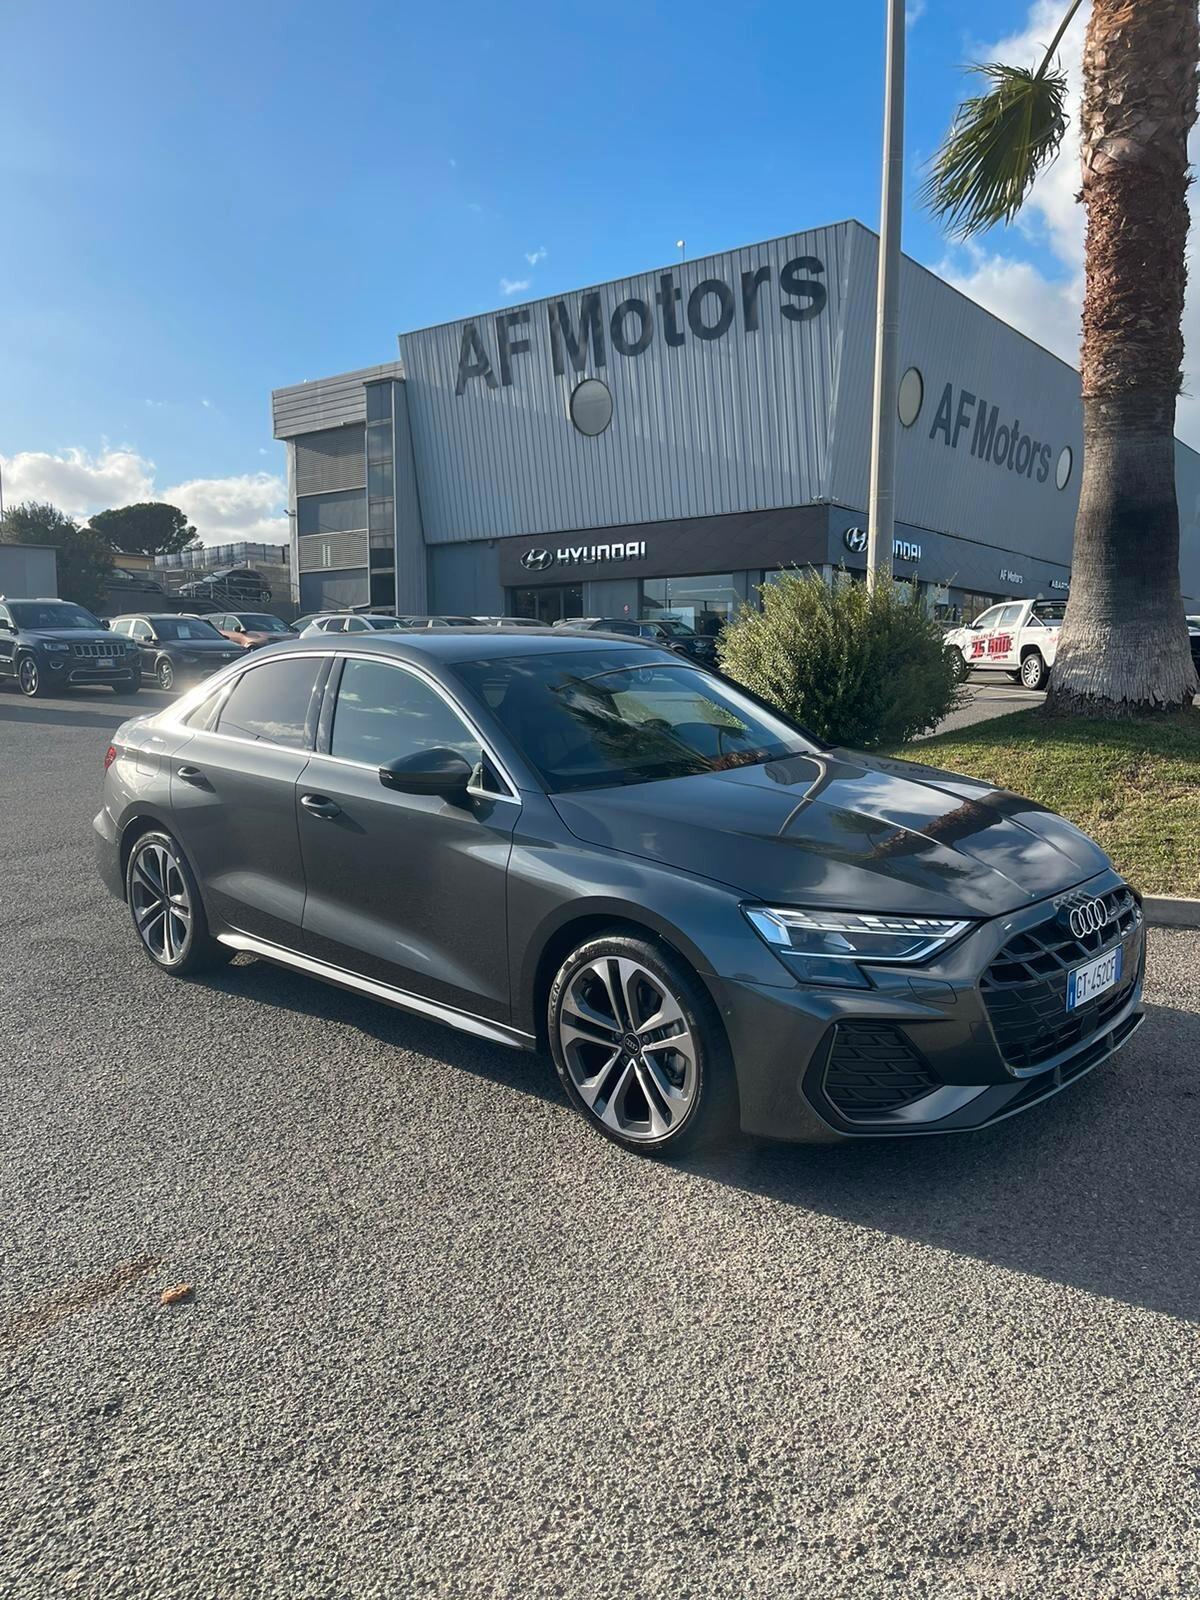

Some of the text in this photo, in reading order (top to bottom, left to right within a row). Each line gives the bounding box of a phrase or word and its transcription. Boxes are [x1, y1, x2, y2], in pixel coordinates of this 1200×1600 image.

[455, 256, 827, 396] AF Motors
[929, 382, 1051, 483] AF Motors
[557, 541, 646, 563] HYUNDAI
